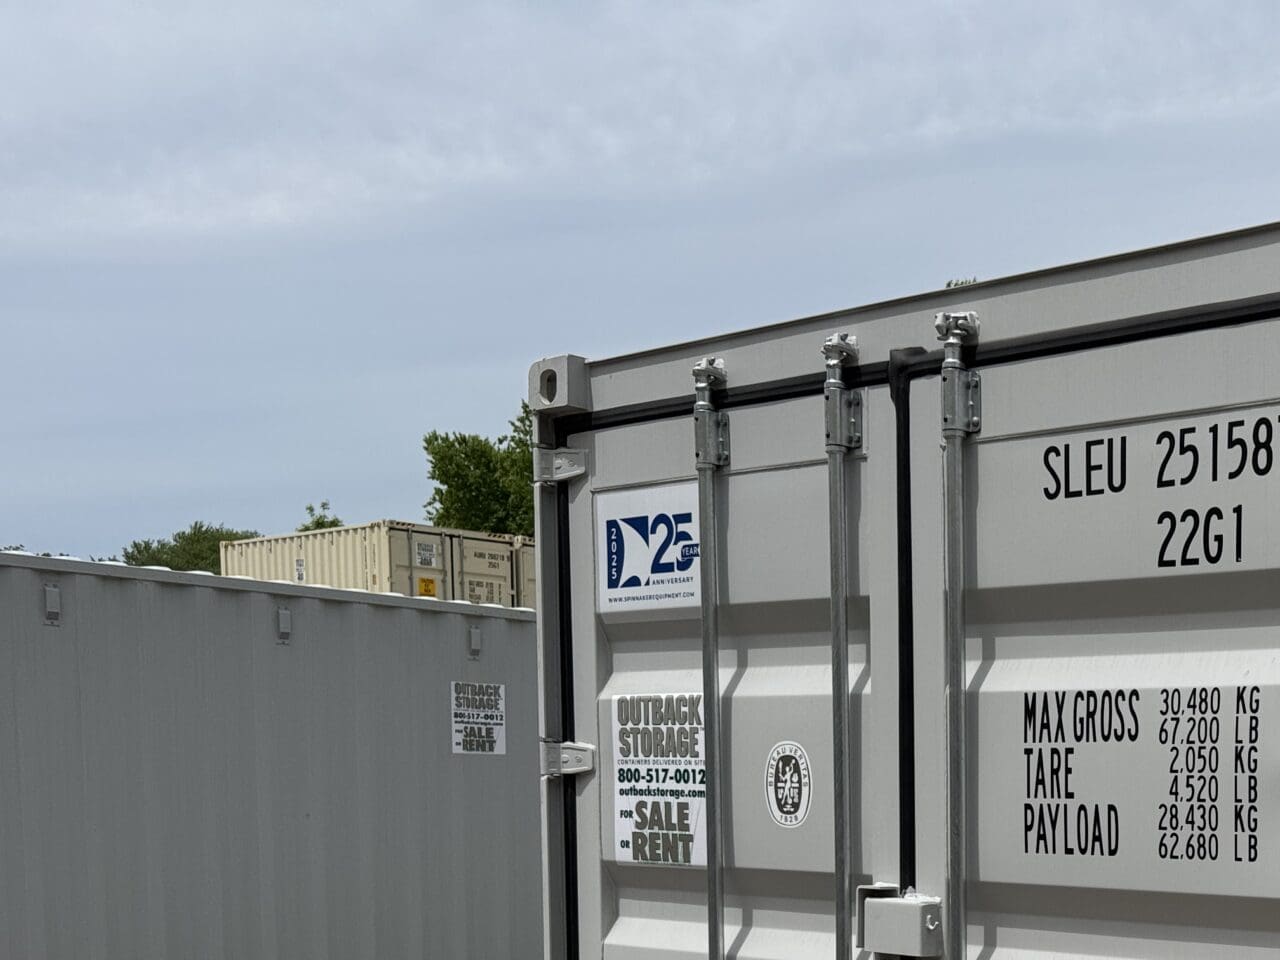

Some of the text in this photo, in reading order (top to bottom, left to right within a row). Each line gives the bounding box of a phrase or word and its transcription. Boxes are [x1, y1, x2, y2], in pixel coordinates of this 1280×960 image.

[1043, 436, 1127, 500] SLEU
[649, 512, 695, 574] 25
[1157, 504, 1242, 568] 22G1
[652, 576, 694, 586] ANNIVERSARY
[454, 683, 501, 697] OUTBACK
[455, 696, 500, 710] STORAGE
[617, 695, 702, 726] OUTBACK
[1024, 686, 1260, 743] MAX GROSS 30,480 KG
[462, 739, 497, 752] RENT
[463, 726, 494, 739] SALE
[619, 727, 699, 758] STORAGE
[1158, 716, 1259, 745] 67,200 LB
[618, 768, 706, 784] 800-517-0012
[768, 746, 787, 788] BUREAU
[1024, 746, 1258, 800] TARE 2,050 KG
[619, 785, 705, 799] outbackstorage.com
[1169, 775, 1258, 803] 4,520 LB
[620, 800, 690, 832] FOR SALE
[1024, 803, 1258, 856] PAYLOAD 28,430 KG
[620, 832, 694, 864] OR RENT
[1158, 833, 1258, 862] 62,680 LB
